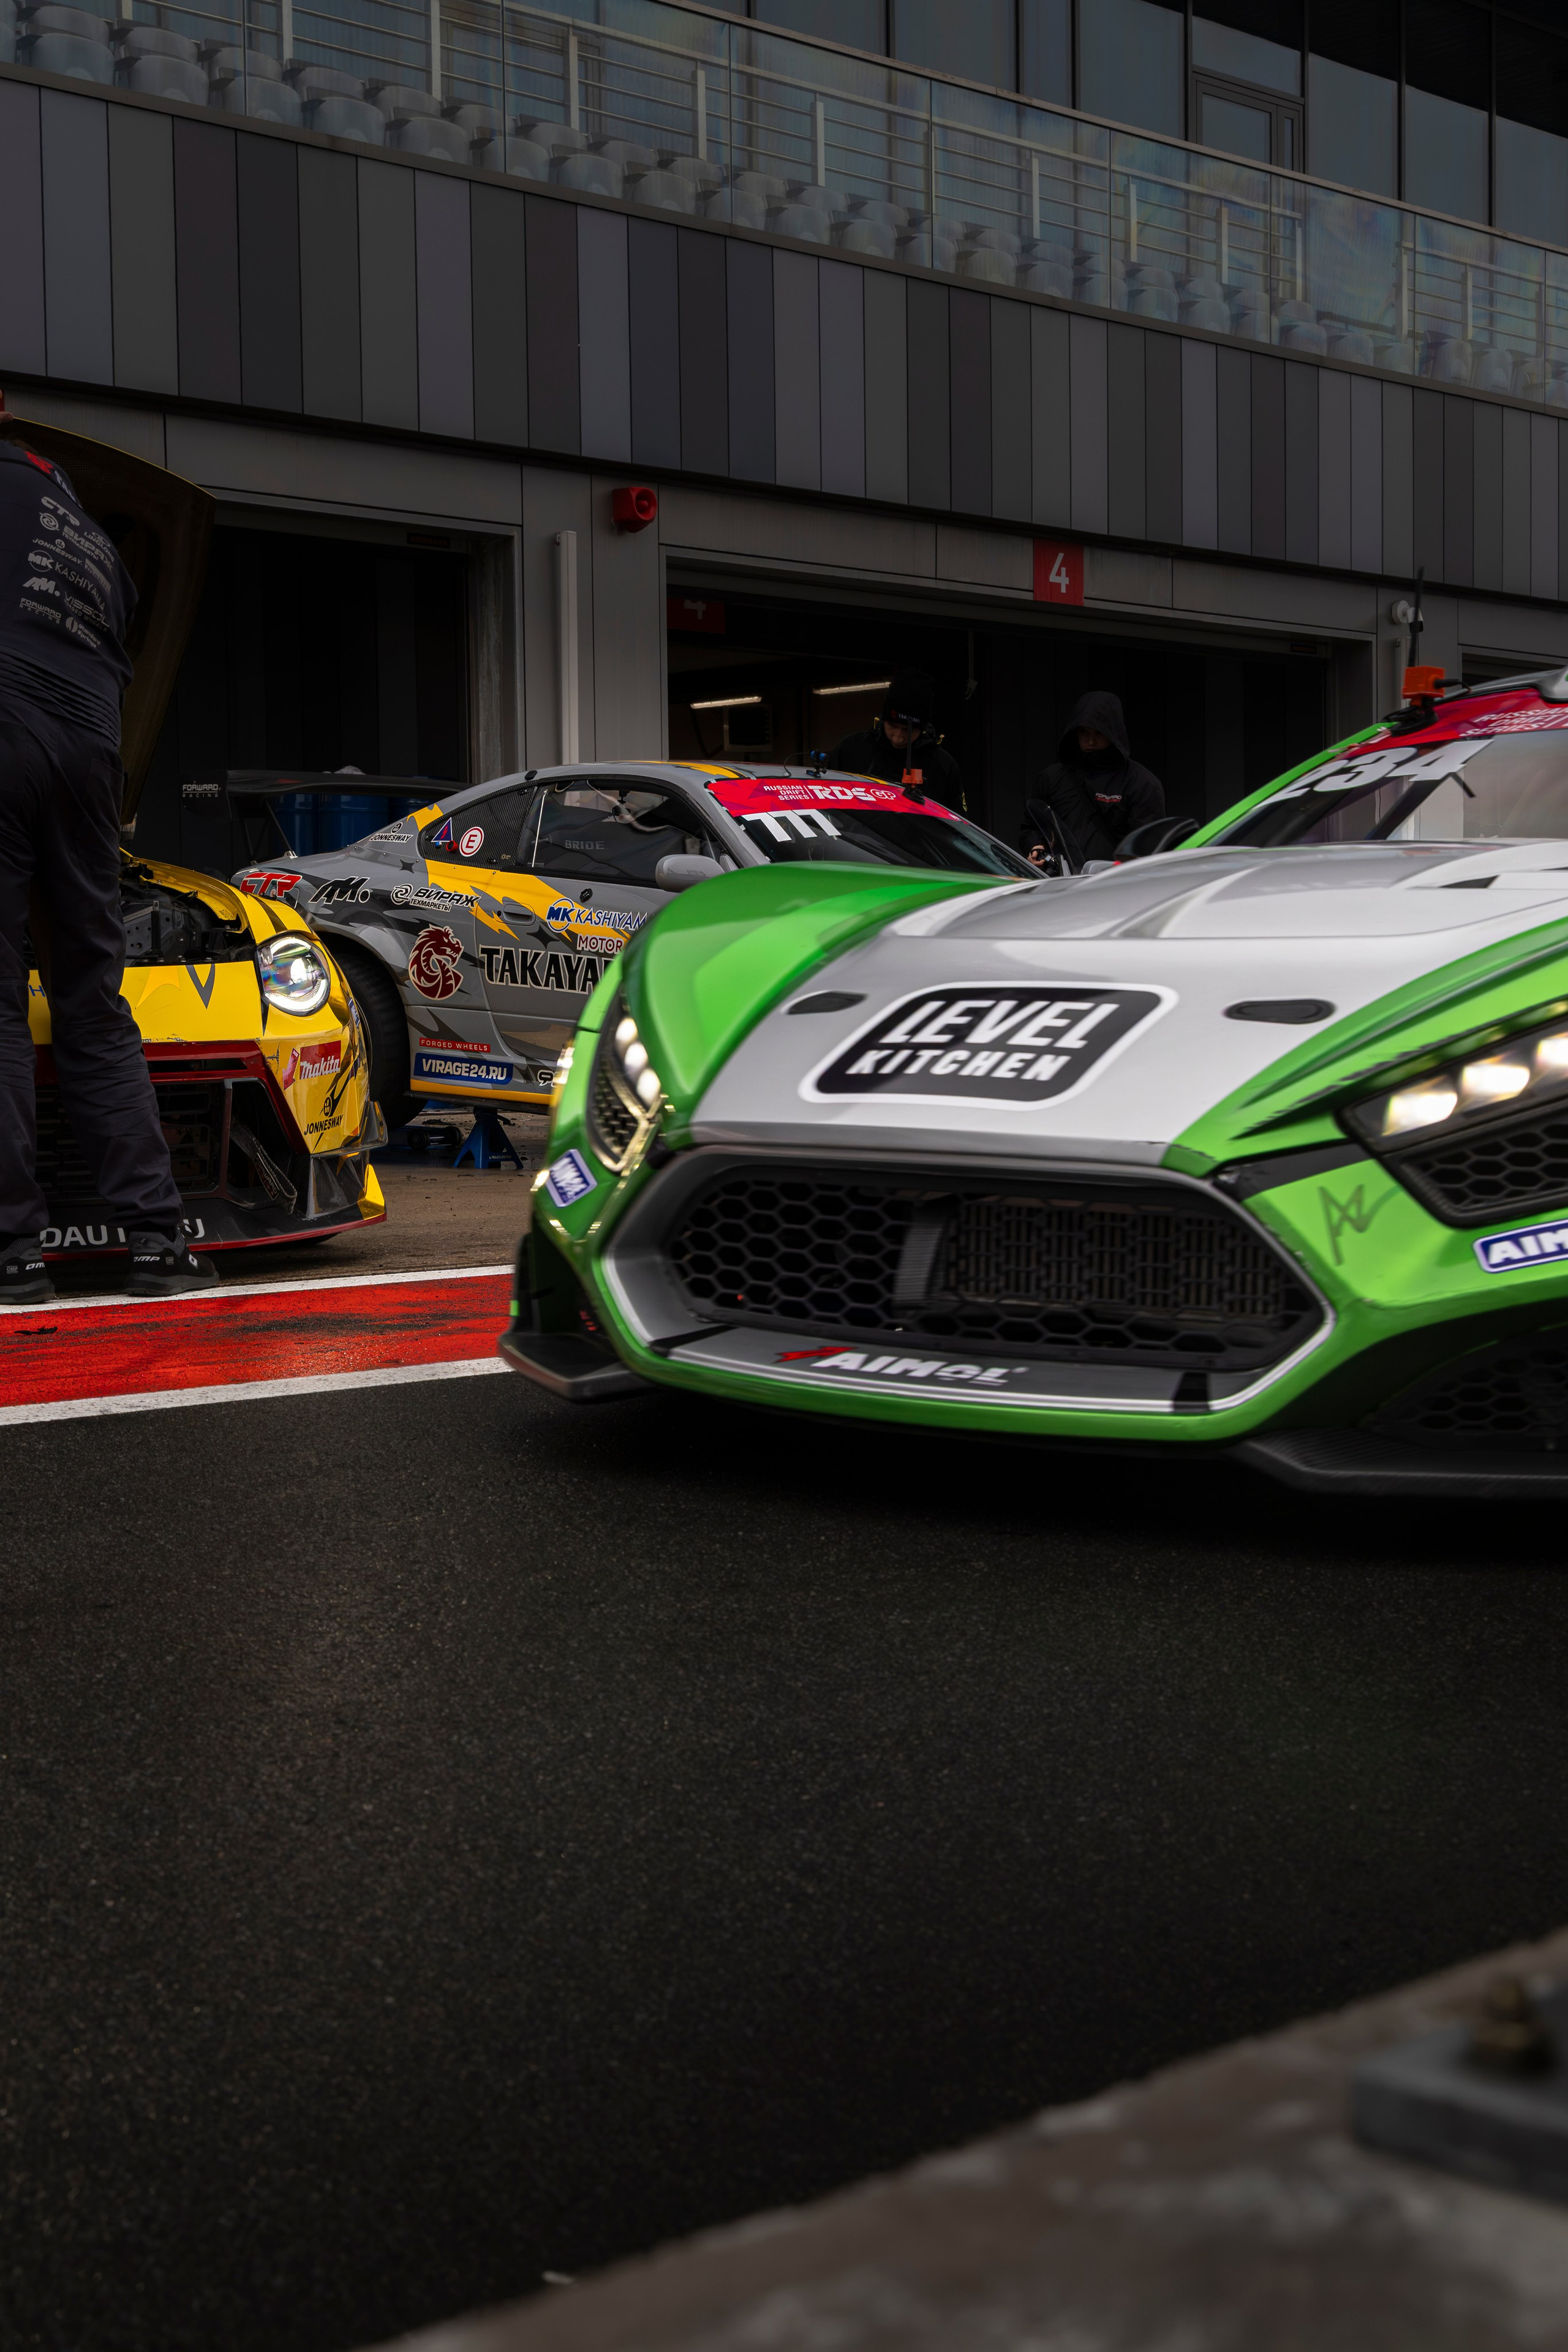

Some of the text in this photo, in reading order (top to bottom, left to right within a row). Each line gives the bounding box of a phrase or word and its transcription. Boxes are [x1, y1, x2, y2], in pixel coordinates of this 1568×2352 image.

[64, 526, 113, 573] ВИРАЖ
[84, 532, 115, 562] LINGLONG
[28, 552, 105, 611] MK KASHIYAMA
[1049, 552, 1069, 594] 4
[20, 598, 61, 619] FORWARD
[20, 605, 60, 624] RACING
[65, 591, 110, 628] VISSOL
[1458, 722, 1545, 736] SERIES
[1487, 714, 1564, 727] DRIFT
[1254, 739, 1494, 809] 234
[807, 785, 896, 801] RDS GP
[741, 809, 842, 843] 777
[371, 834, 412, 842] JONNESWAY
[465, 834, 477, 849] E
[565, 840, 605, 850] BRIDE
[410, 899, 451, 911] ТЕХМАРКЕТЫ
[413, 888, 480, 907] ВИРАЖ
[546, 907, 576, 922] MK
[578, 936, 624, 953] MOTOR
[878, 1000, 1120, 1049] LEVEL
[421, 1039, 488, 1051] FORGED WHEELS
[422, 1058, 507, 1080] VIRAGE24.RU
[845, 1049, 1072, 1081] KITCHEN
[304, 1114, 344, 1135] JONNESWAY
